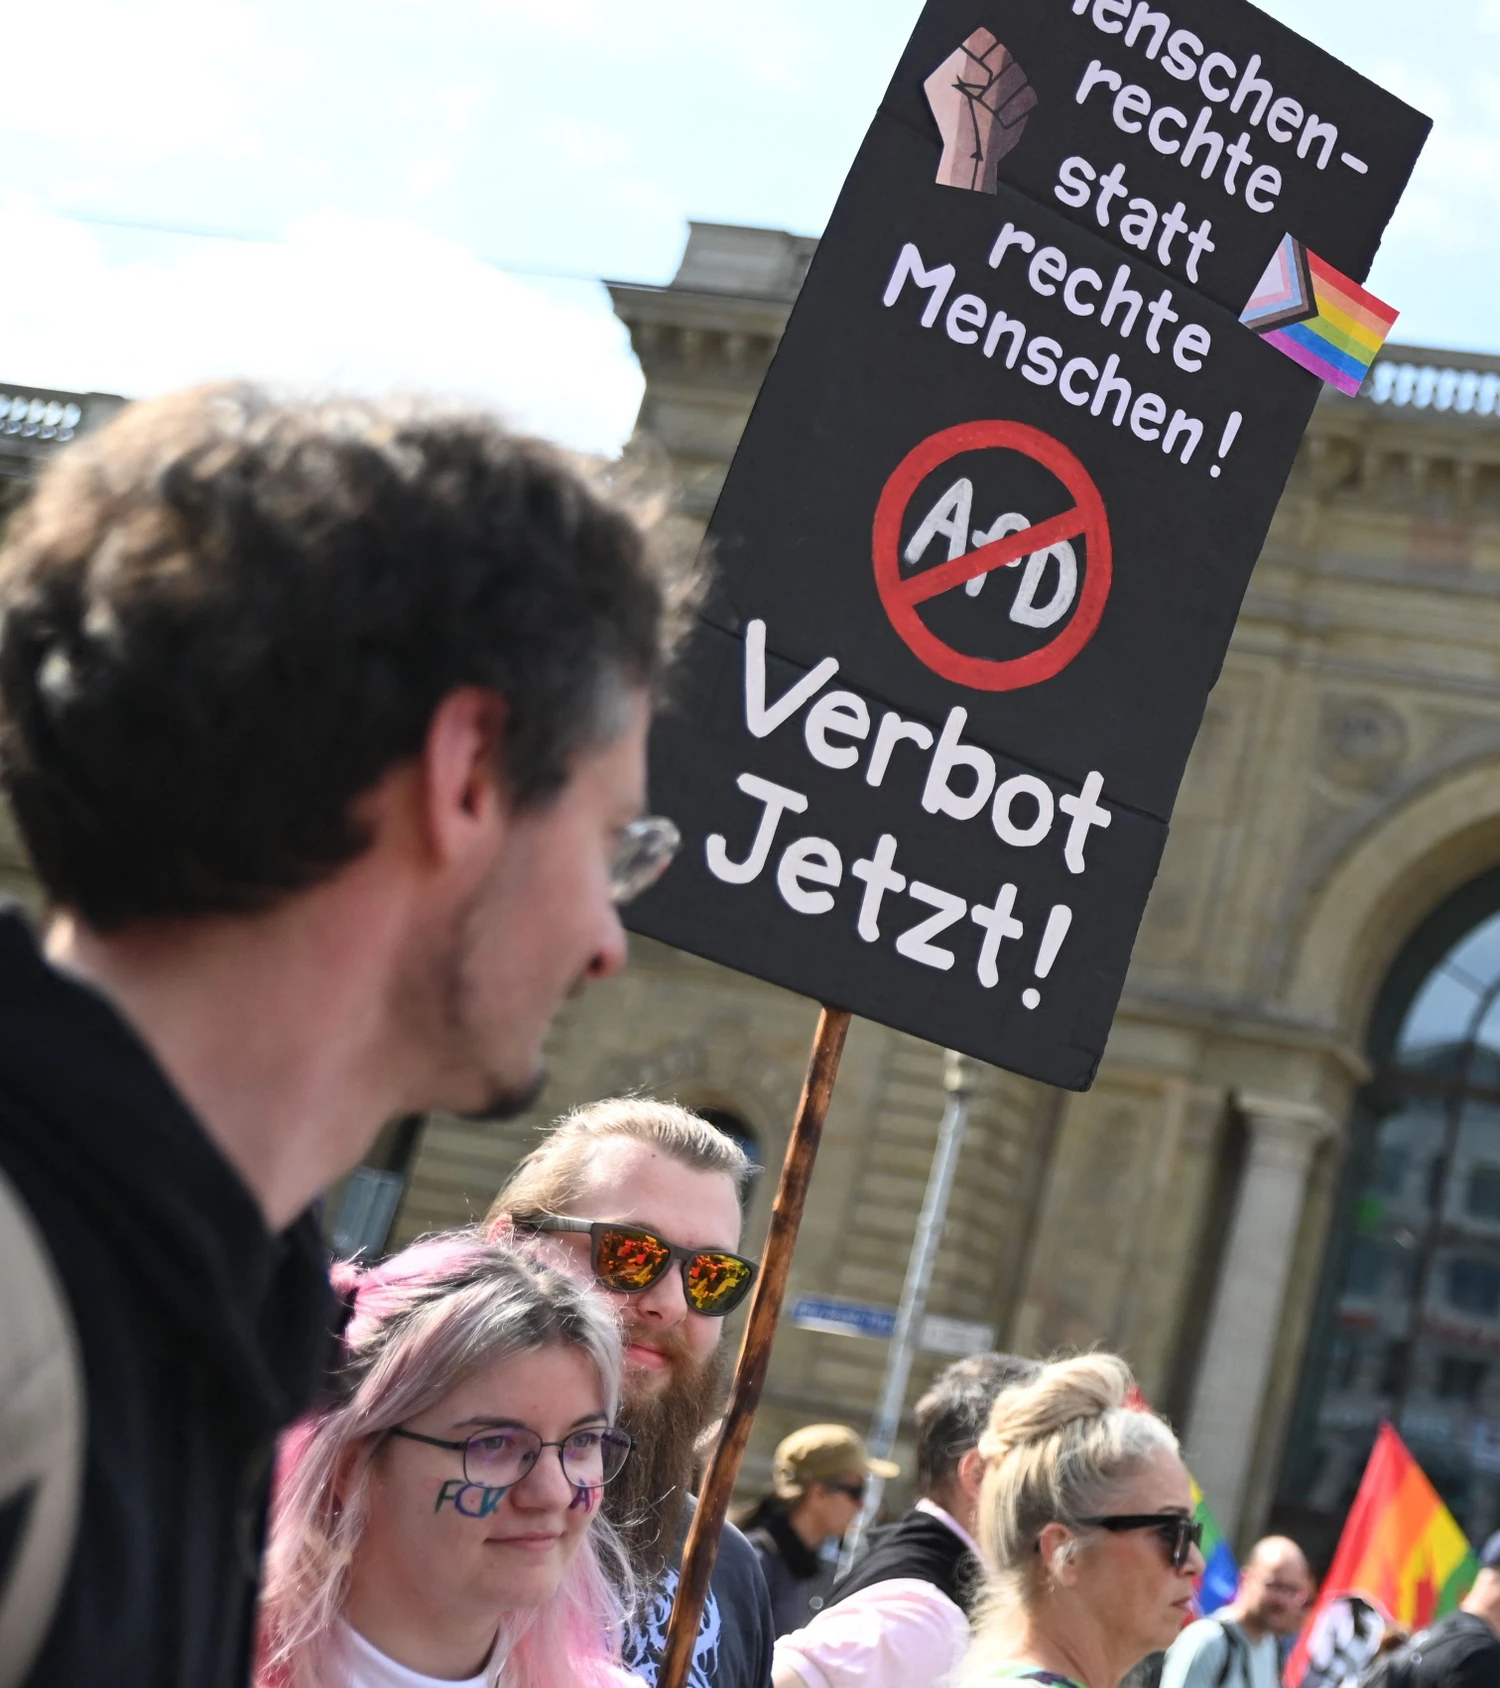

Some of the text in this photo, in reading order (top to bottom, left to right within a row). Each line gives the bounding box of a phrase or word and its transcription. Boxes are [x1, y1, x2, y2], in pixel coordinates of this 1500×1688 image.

[1072, 0, 1368, 174] enschen-
[1076, 60, 1281, 213] rechte
[989, 223, 1210, 372] rechte
[1054, 157, 1215, 283] statt
[883, 243, 1242, 478] Menschen!
[745, 619, 1111, 873] Verbot
[706, 773, 1072, 1009] Jetzt!
[434, 1478, 508, 1519] FCK
